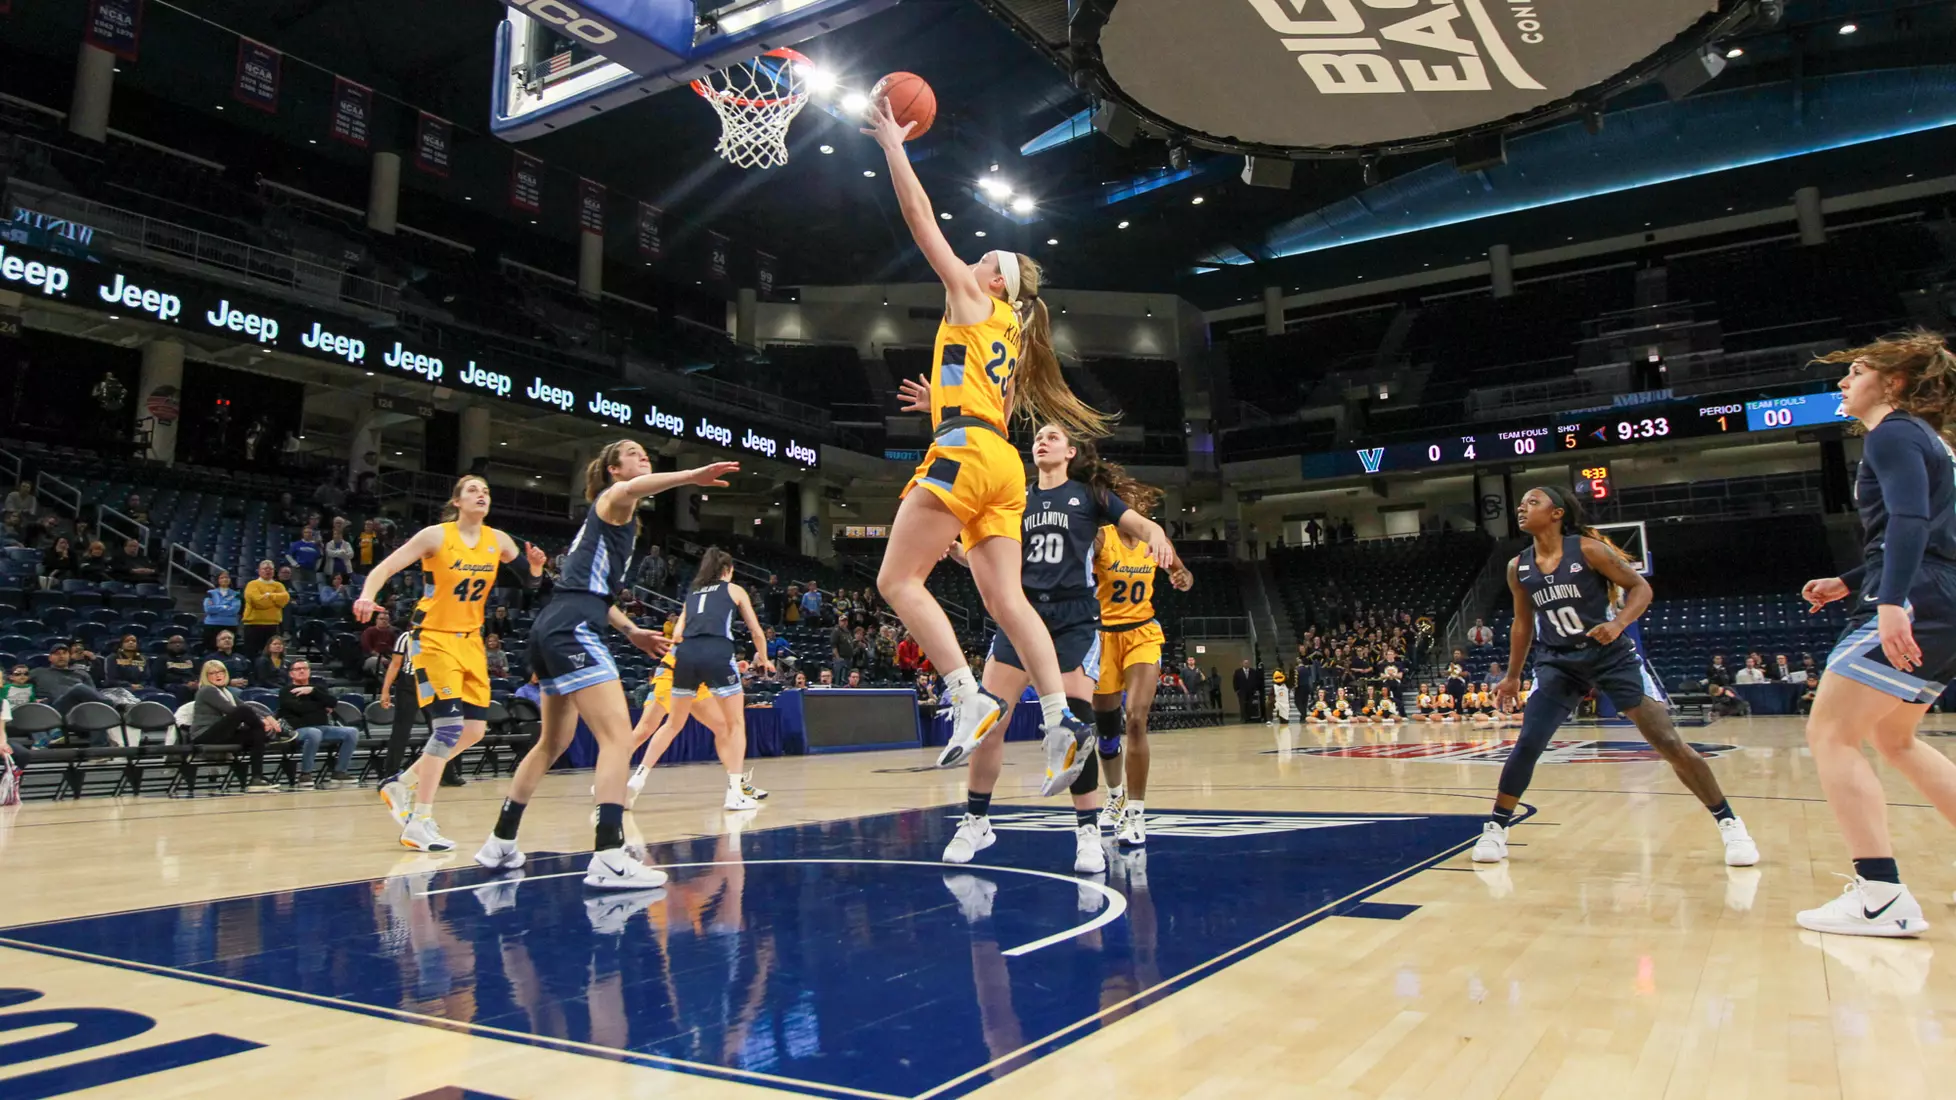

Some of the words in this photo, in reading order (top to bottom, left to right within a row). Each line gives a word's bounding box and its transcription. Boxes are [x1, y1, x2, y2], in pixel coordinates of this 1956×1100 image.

[99, 6, 132, 26] NCAA
[512, 0, 618, 44] CO
[1507, 0, 1544, 43] CON
[1359, 0, 1492, 92] EA
[244, 62, 273, 80] NCAA
[339, 100, 364, 118] NCAA
[711, 251, 726, 265] 24
[1746, 401, 1773, 411] TEAM
[1773, 396, 1806, 408] FOULS
[1829, 391, 1843, 401] TO
[1699, 402, 1742, 417] PERIOD
[1763, 408, 1792, 427] 00
[1557, 423, 1581, 433] SHOT
[1616, 416, 1670, 441] 9:33
[1717, 416, 1728, 432] 1
[1461, 436, 1476, 444] TOL
[1497, 430, 1522, 441] TEAM
[1522, 427, 1549, 438] FOULS
[1564, 433, 1577, 449] 5
[1427, 444, 1441, 462] 0
[1463, 444, 1476, 460] 4
[1513, 437, 1536, 455] 00
[1590, 478, 1607, 499] 5
[1023, 511, 1069, 533] VILLANOVA
[1026, 532, 1065, 564] 30
[453, 577, 487, 603] 42
[1110, 579, 1146, 605] 20
[1531, 583, 1582, 608] VILLANOVA
[696, 593, 708, 615] 1
[1545, 605, 1585, 638] 10
